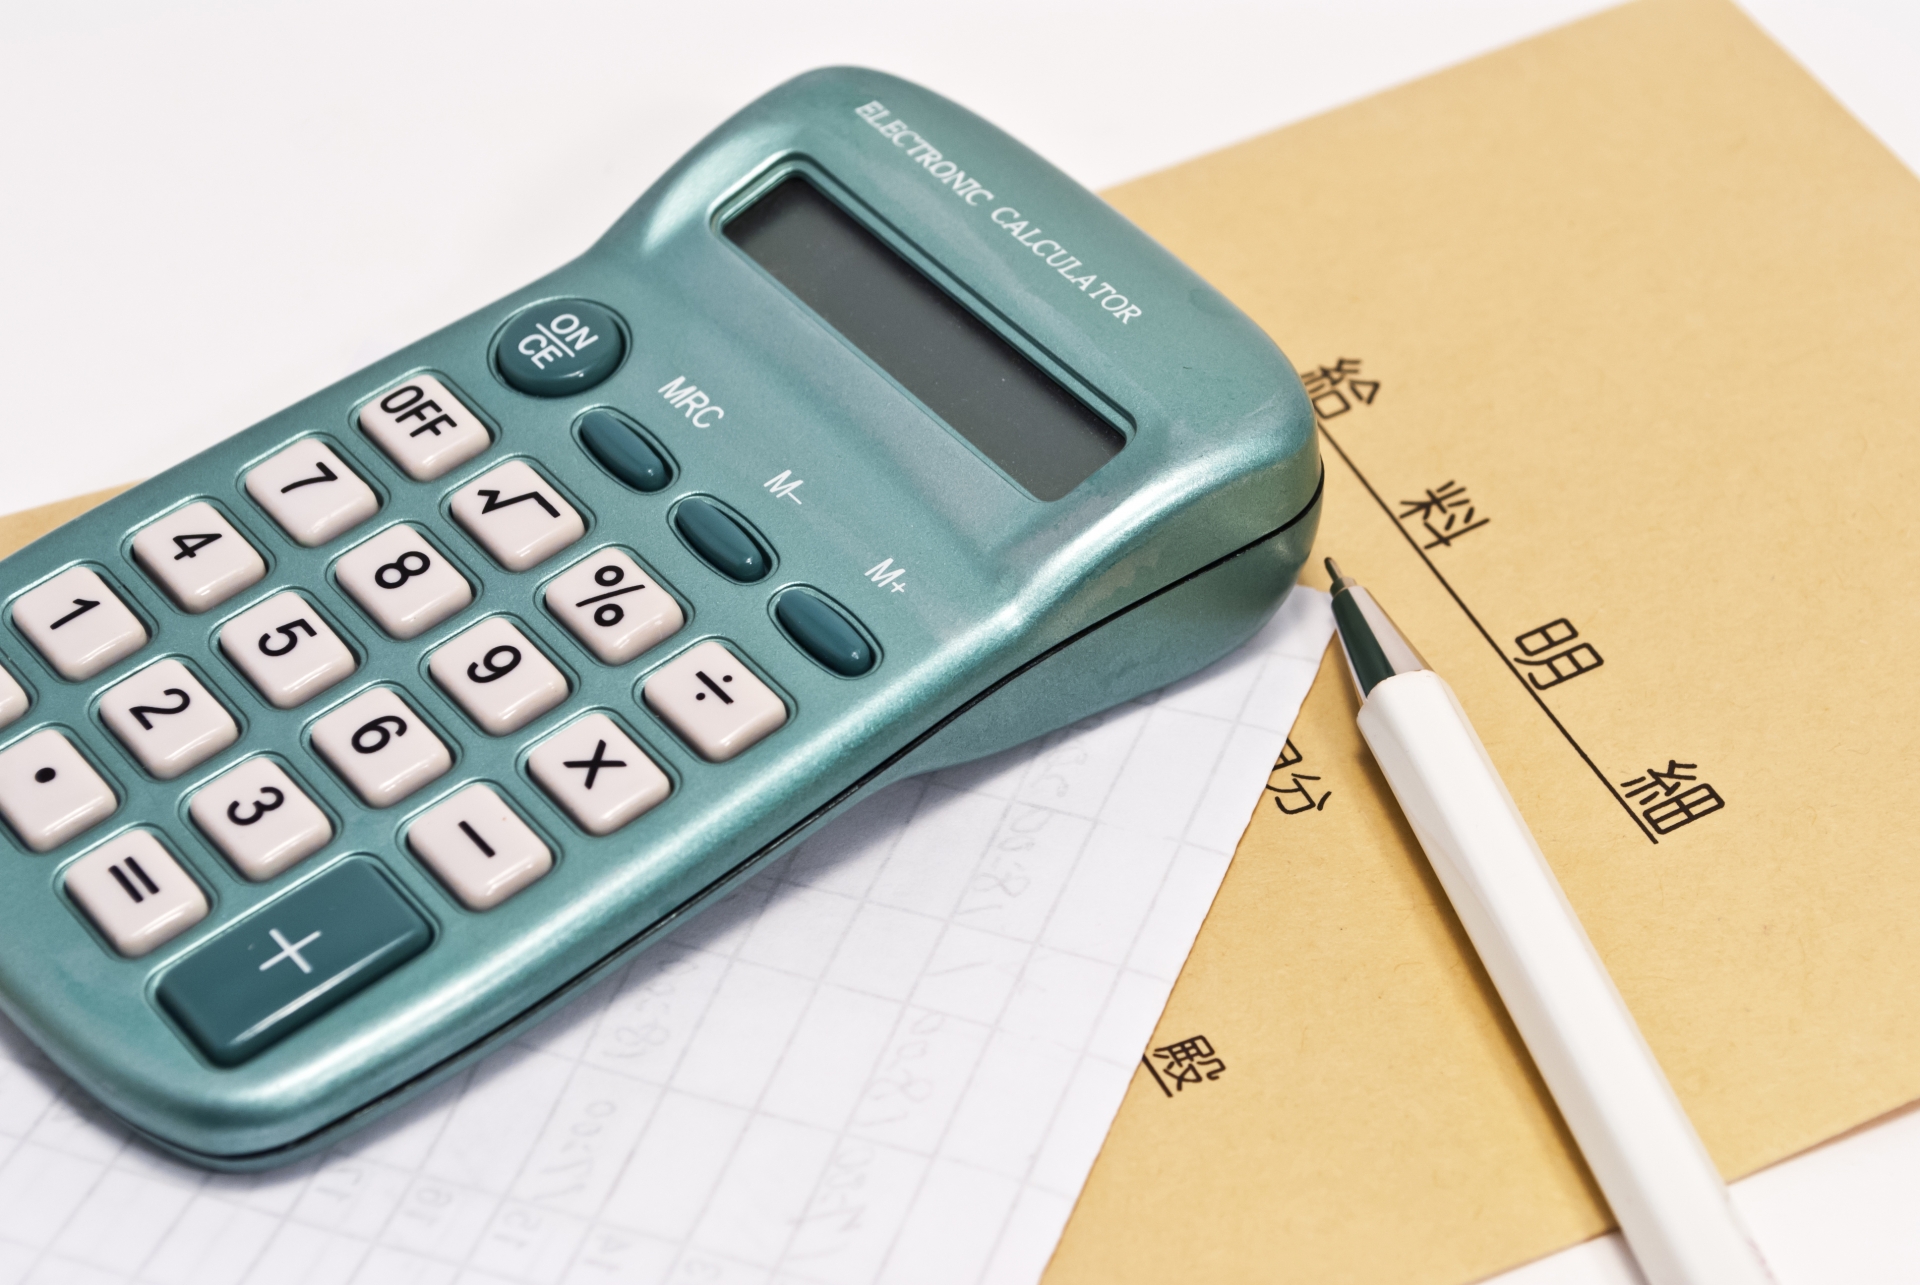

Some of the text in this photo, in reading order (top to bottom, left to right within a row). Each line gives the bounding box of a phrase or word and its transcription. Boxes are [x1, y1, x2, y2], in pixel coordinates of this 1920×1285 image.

[854, 99, 1142, 325] ELECTRONIC CALCULATOR
[518, 332, 563, 370] CE
[550, 313, 599, 351] ON
[380, 385, 457, 437] OFF
[658, 376, 724, 428] MRC
[281, 462, 337, 493] 7
[173, 534, 222, 560] 4
[375, 551, 430, 589] 8
[864, 557, 906, 593] M+
[50, 599, 100, 629] 1
[575, 565, 645, 626] %
[259, 619, 317, 656] 5
[467, 646, 521, 683] 9
[130, 689, 190, 730] 2
[352, 716, 407, 754] 6
[228, 787, 284, 825] 3
[1154, 1035, 1226, 1091] 殿
